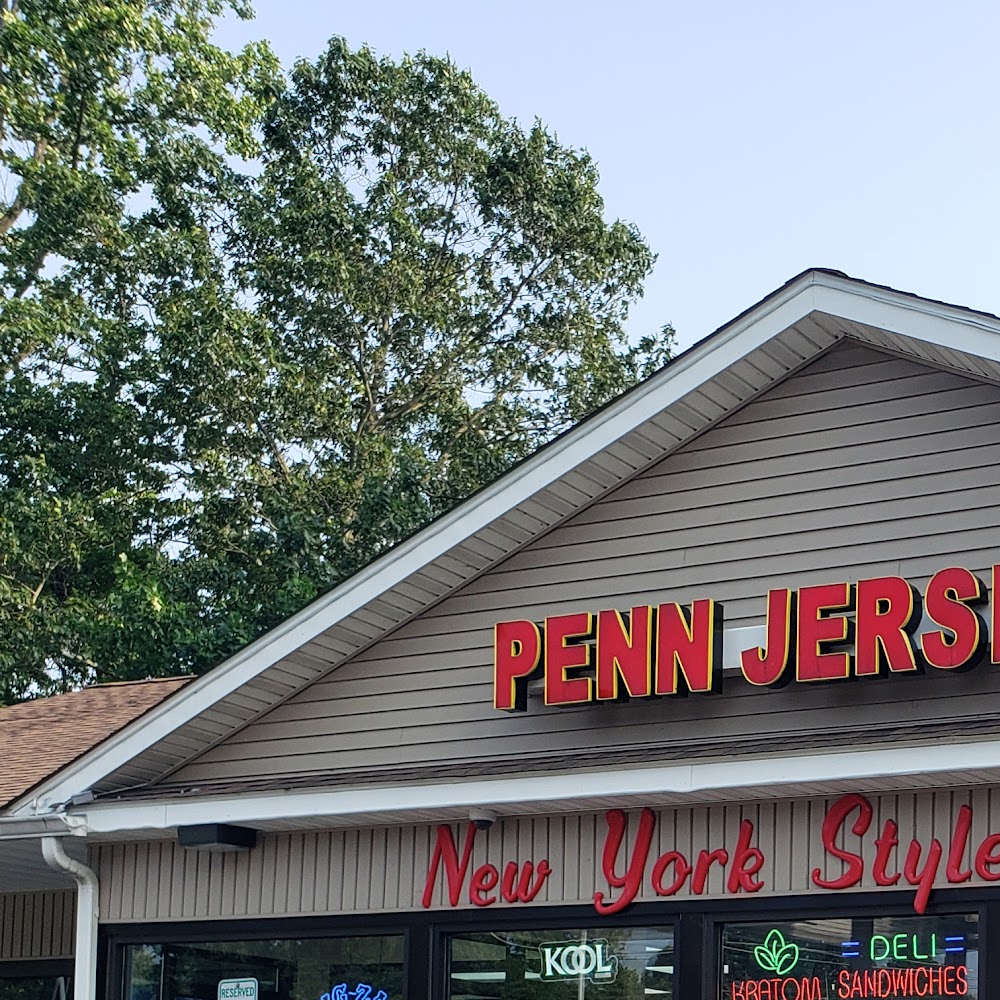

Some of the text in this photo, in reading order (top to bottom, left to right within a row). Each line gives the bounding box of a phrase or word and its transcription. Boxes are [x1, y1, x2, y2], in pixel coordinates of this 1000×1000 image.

[493, 598, 717, 712] PENN
[423, 820, 551, 909] New
[594, 807, 764, 915] York
[544, 943, 613, 977] KOOL
[870, 933, 936, 961] DELI
[221, 986, 255, 998] RESERVED
[838, 965, 968, 1000] SANDWICHES
